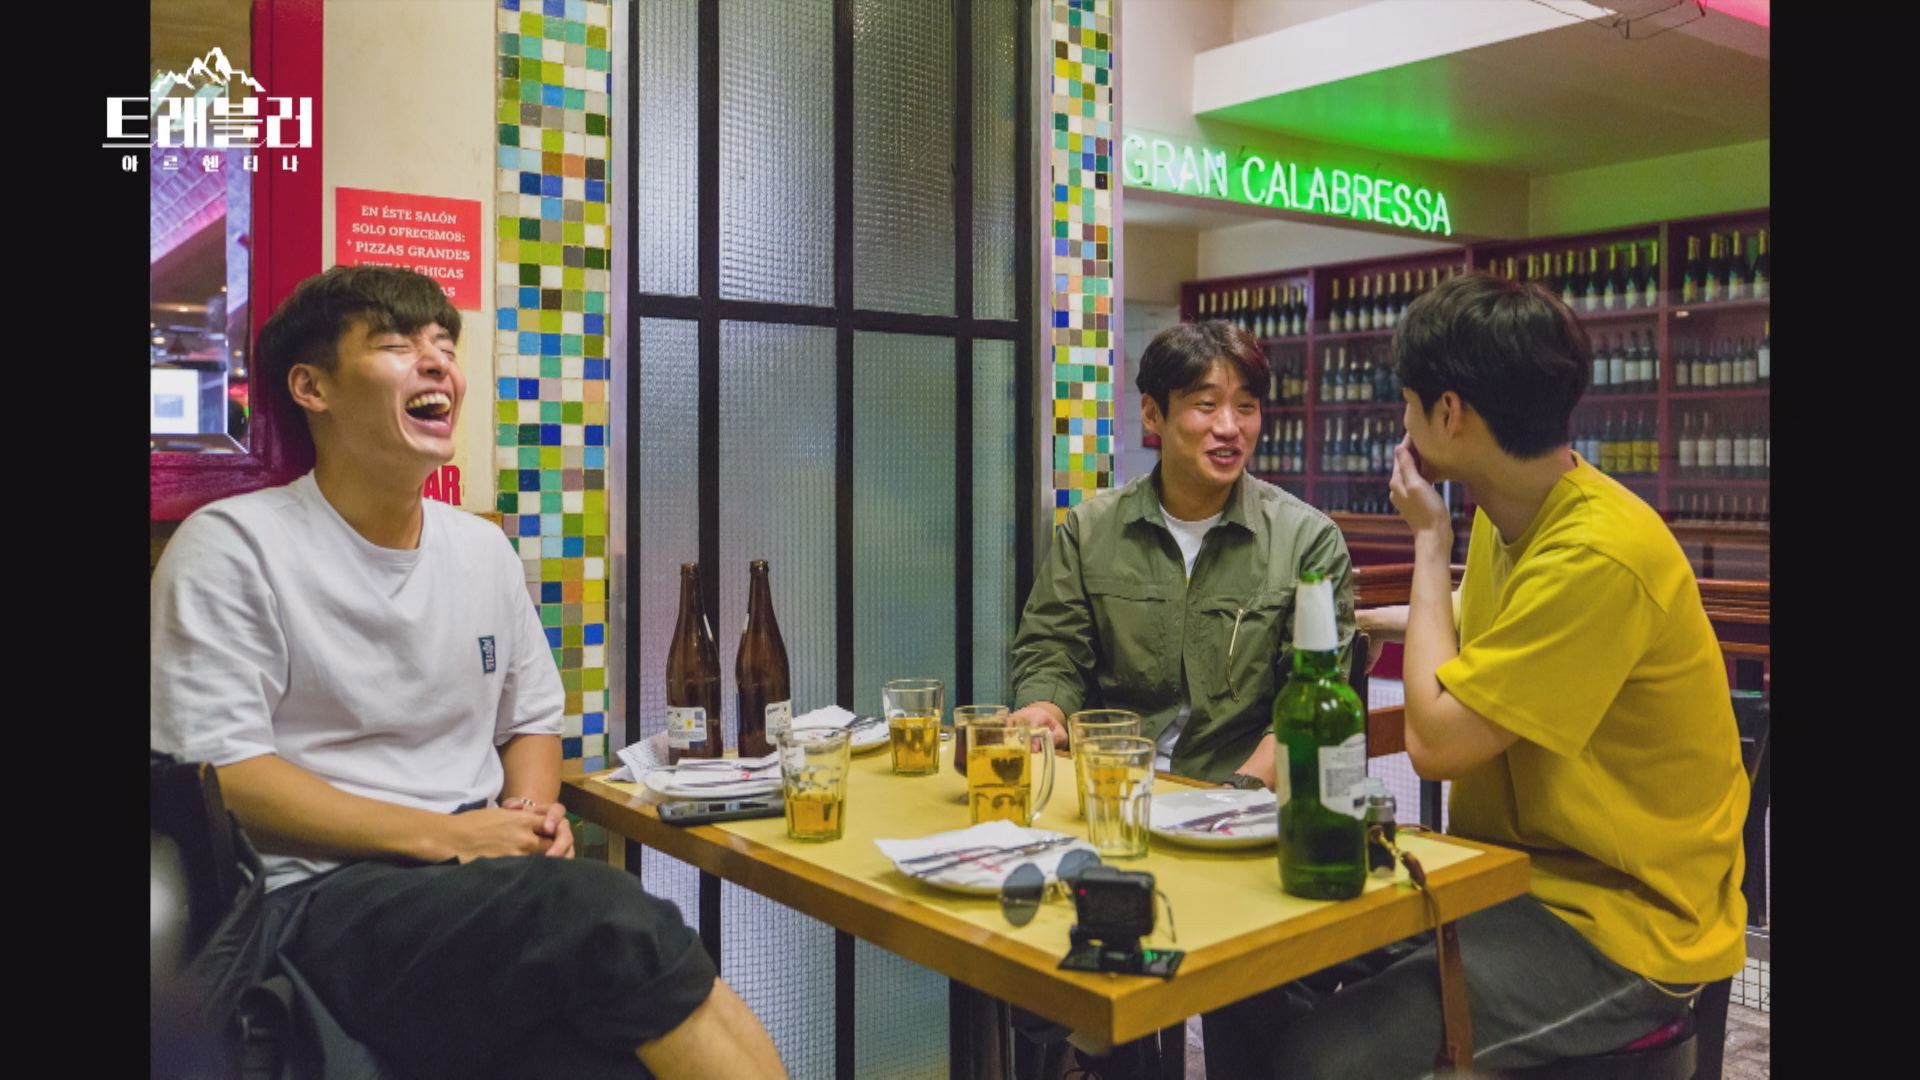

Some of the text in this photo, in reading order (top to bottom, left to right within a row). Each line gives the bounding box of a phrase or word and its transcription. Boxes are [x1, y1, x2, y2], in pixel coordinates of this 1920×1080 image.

[1122, 135, 1451, 236] GRAN CALABRESSA
[361, 205, 457, 224] EN ÉSTE SALÓN
[352, 223, 465, 243] SOLO OFRECEMOS:
[355, 241, 470, 261] PIZZAS GRANDES
[415, 264, 464, 279] CHICAS
